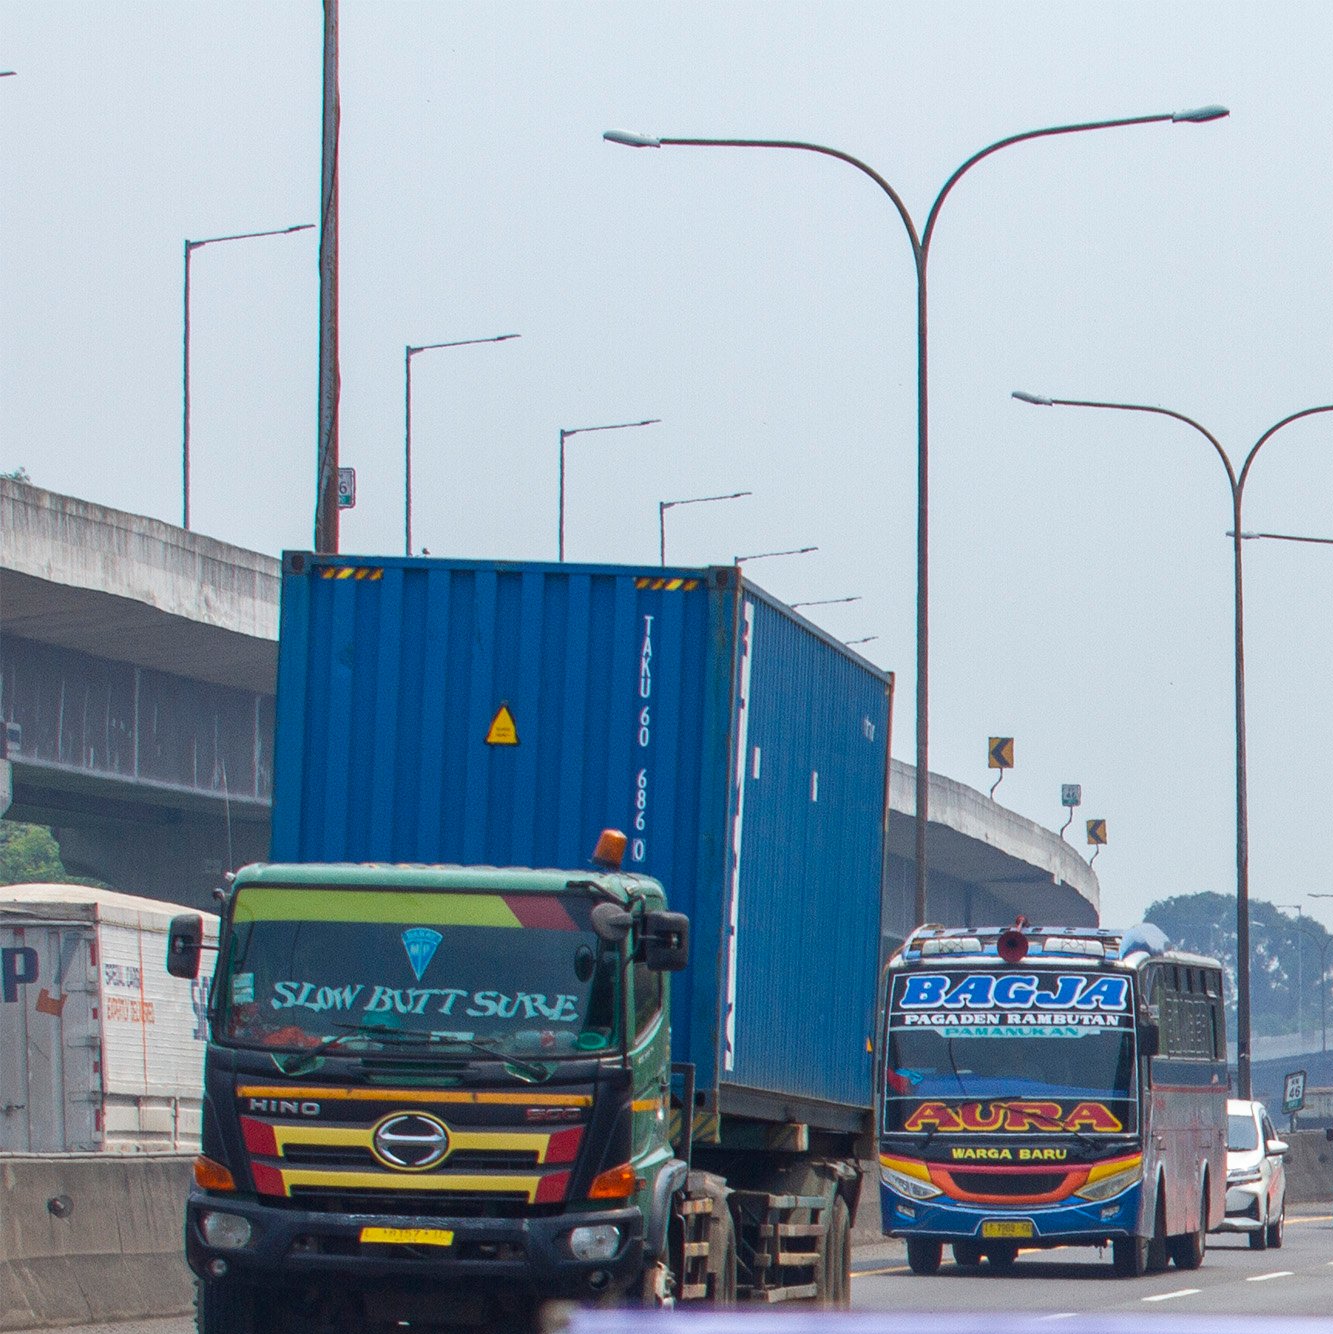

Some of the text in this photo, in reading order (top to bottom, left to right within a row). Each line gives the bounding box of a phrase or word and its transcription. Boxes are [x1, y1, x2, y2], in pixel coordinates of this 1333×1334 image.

[640, 615, 654, 698] TAKU
[271, 980, 579, 1022] SLOW BUTT SURE
[900, 975, 1128, 1010] BAGJA
[904, 1014, 1120, 1026] PAGADEN RAMBUTAN
[944, 1027, 1080, 1036] PAMANUKAN
[1290, 1086, 1300, 1098] 46
[250, 1098, 321, 1116] HINO
[904, 1102, 1122, 1132] AURA
[952, 1148, 1068, 1159] WARGA BARU
